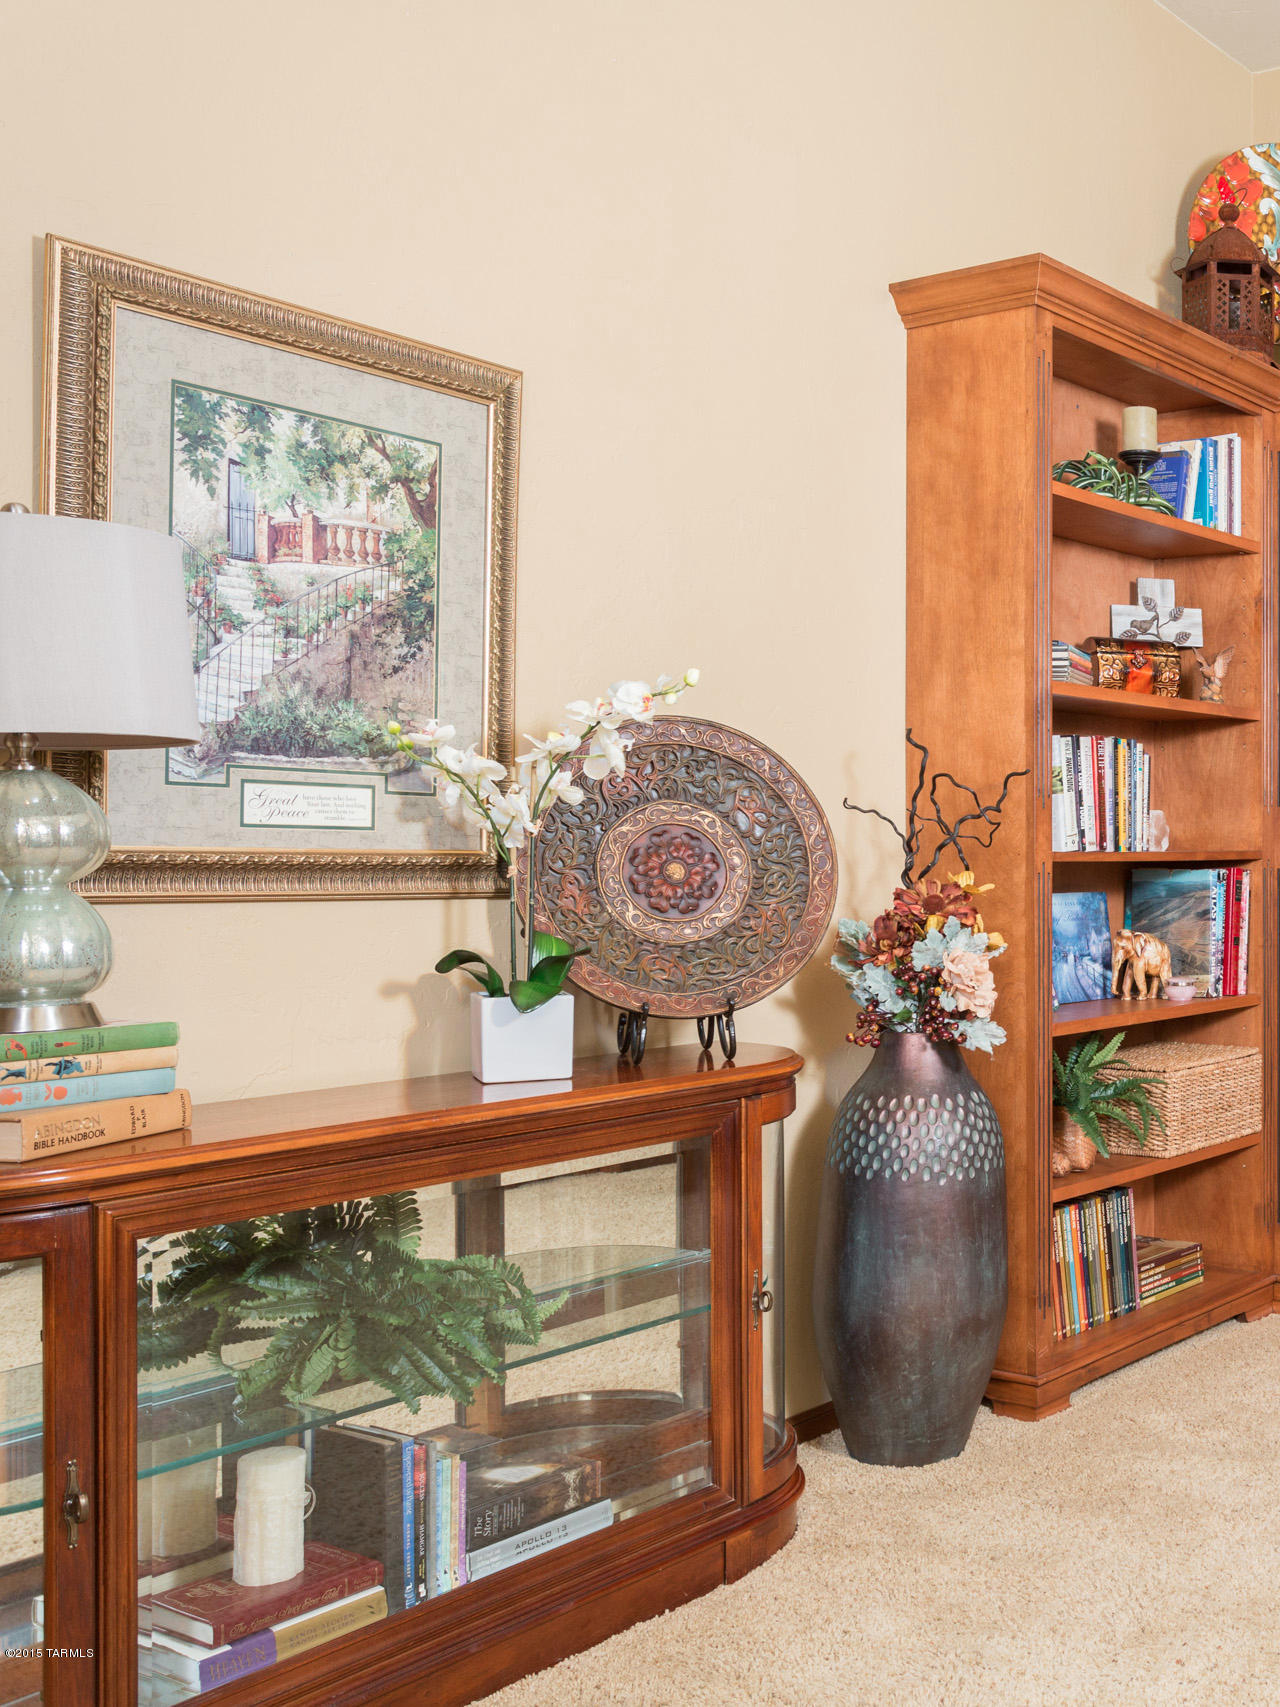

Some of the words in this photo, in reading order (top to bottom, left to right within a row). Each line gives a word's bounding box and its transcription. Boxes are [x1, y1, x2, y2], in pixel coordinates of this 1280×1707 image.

[33, 1138, 55, 1150] BIBLE
[58, 1128, 106, 1146] HANDBOOK
[34, 1113, 101, 1139] ABINGDON
[474, 1516, 483, 1537] The
[482, 1510, 493, 1537] Story
[514, 1530, 552, 1550] APOLLO
[557, 1524, 568, 1535] 13
[209, 1644, 267, 1681] HEAVEN
